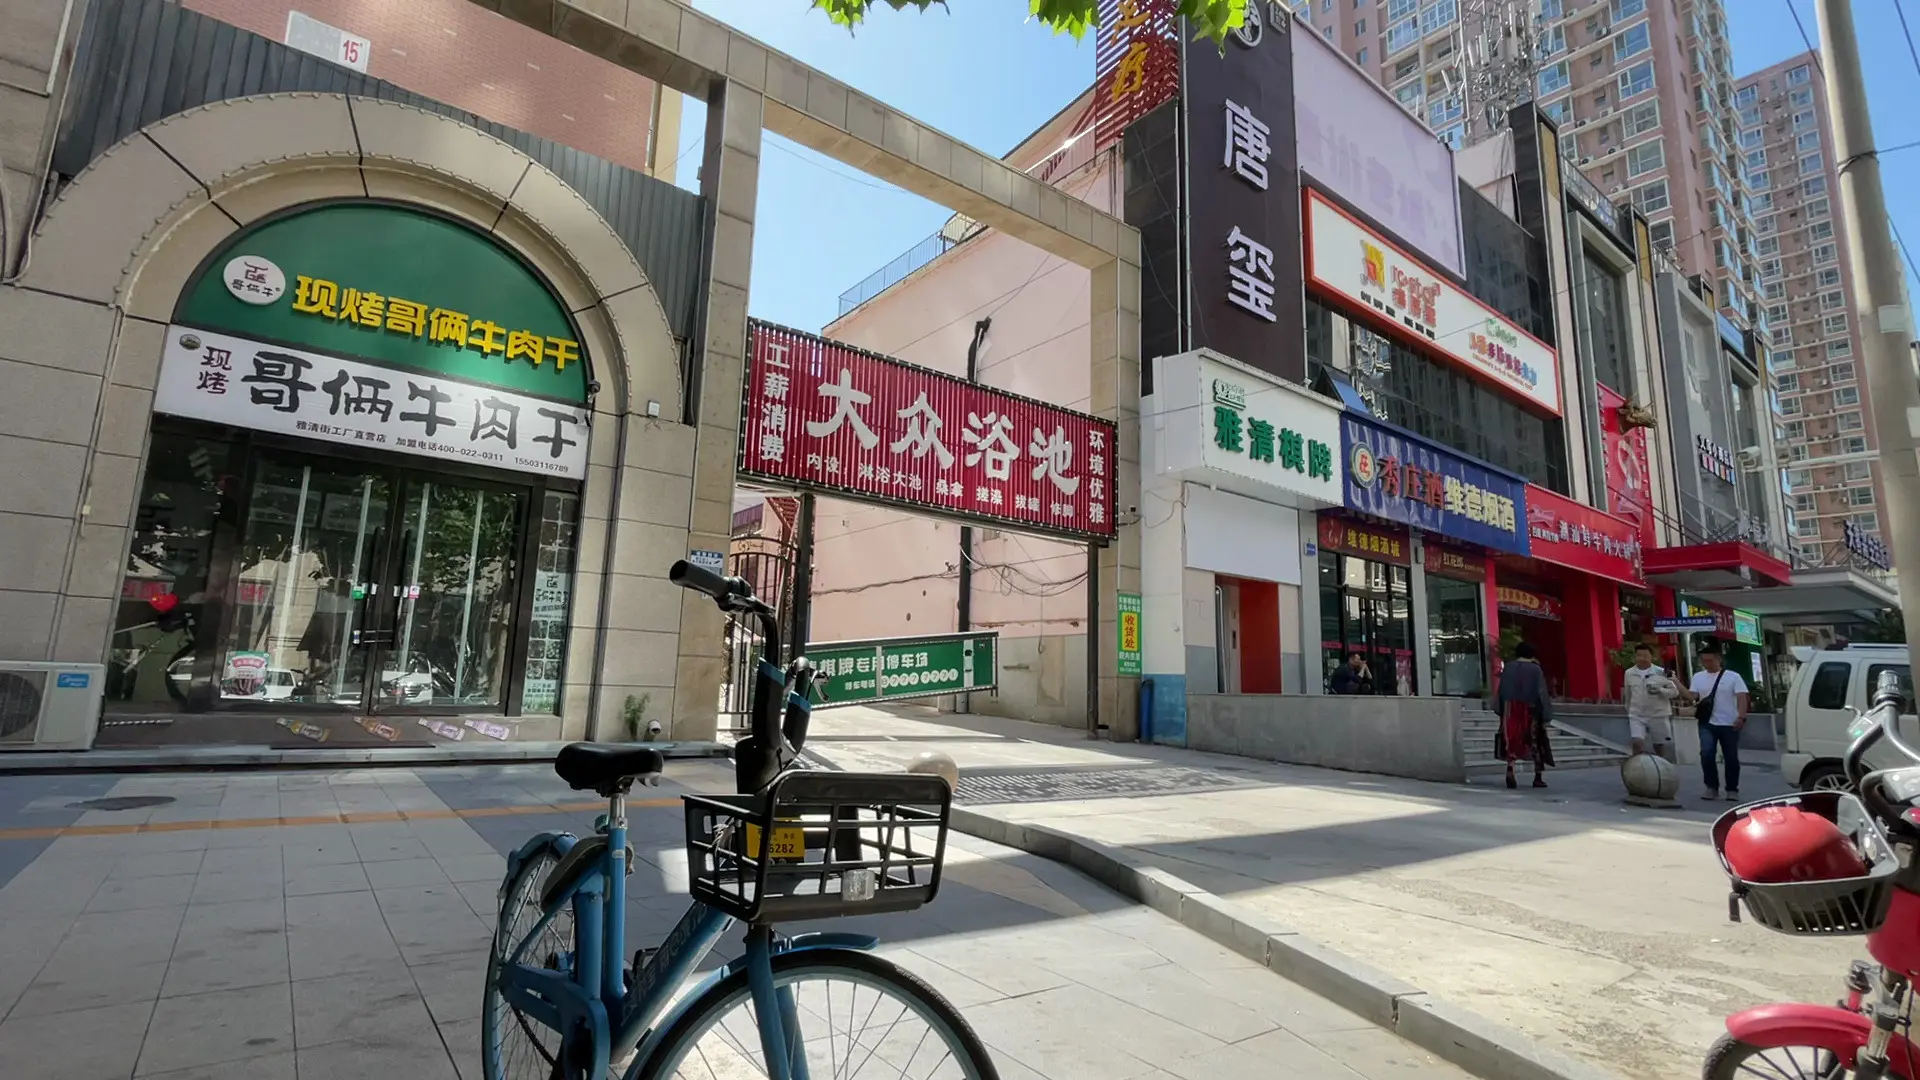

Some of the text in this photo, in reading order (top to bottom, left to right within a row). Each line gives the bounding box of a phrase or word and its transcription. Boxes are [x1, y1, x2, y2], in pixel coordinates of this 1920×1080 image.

[1225, 97, 1277, 323] 唐玺
[292, 275, 580, 370] 现烤哥俩牛肉干
[196, 346, 232, 395] 现烤
[241, 351, 578, 459] 哥俩牛肉干
[761, 342, 791, 463] 工薪消费
[296, 420, 387, 444] 雅清街工厂直营店
[806, 367, 1080, 496] 大众浴池
[859, 463, 923, 490] 淋浴大池
[1088, 429, 1105, 524] 环境优雅
[1214, 405, 1333, 483] 雅清棋牌
[1124, 614, 1135, 649] 收货处
